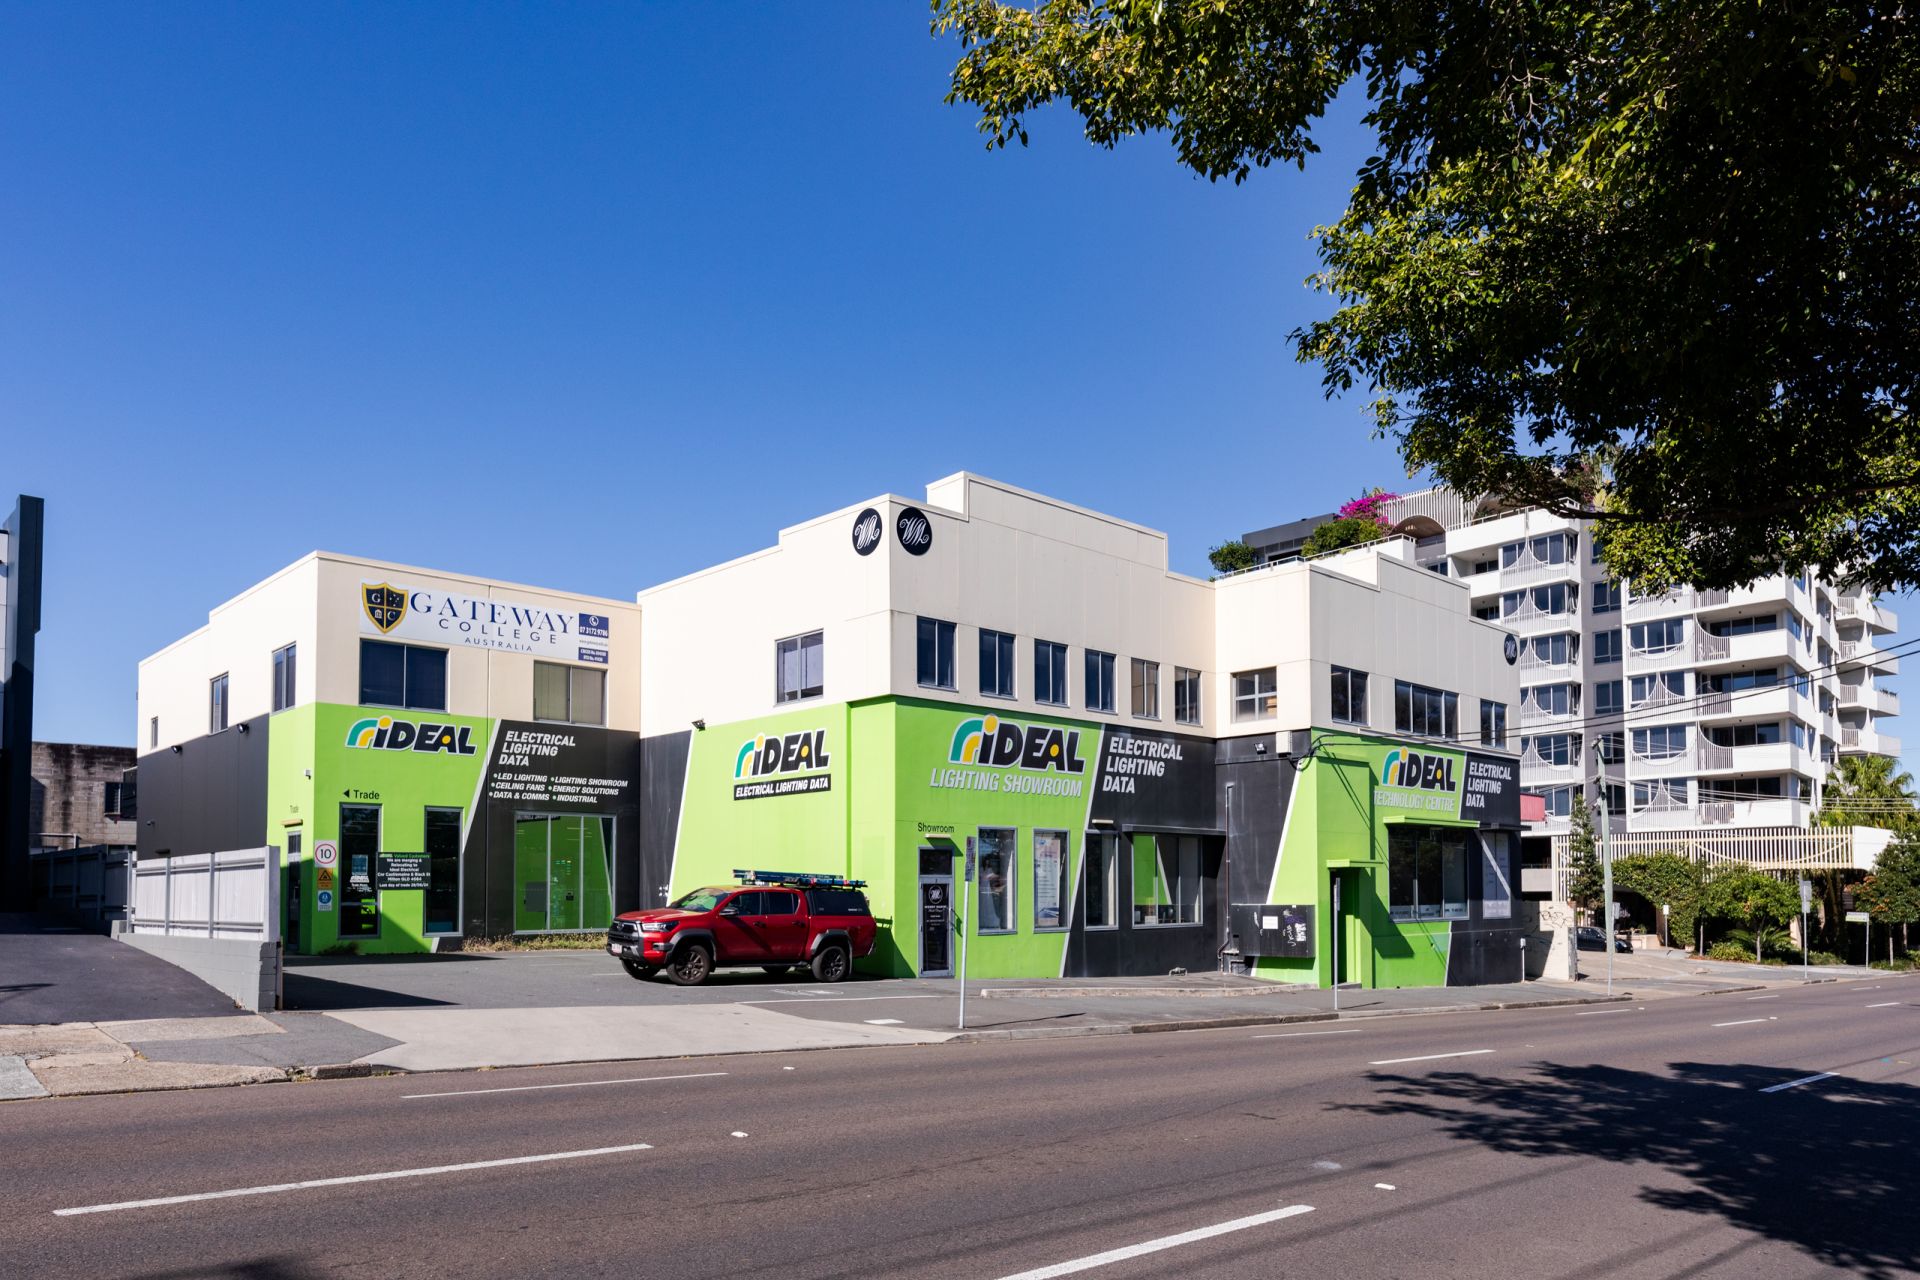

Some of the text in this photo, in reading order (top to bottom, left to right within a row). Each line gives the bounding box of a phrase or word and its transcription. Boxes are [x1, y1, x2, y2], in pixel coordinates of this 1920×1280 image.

[372, 593, 381, 603] G
[388, 610, 396, 620] C
[410, 592, 574, 634] GATEWAY
[439, 618, 556, 644] COLLEGE
[464, 637, 532, 652] AUSTRALIA
[506, 730, 576, 746] ELECTRICAL
[502, 742, 558, 756] LIGHTING
[1109, 736, 1183, 760] ELECTRICAL
[499, 754, 529, 766] DATA
[1106, 756, 1165, 777] LIGHTING
[514, 774, 548, 782] LIGHTING
[1469, 762, 1512, 780] ELECTRICAL
[495, 782, 545, 791] CEILING FANS
[554, 776, 628, 787] LIGHTING SHOWROOM
[736, 777, 828, 797] ELECTRICAL LIGHTING DATA
[930, 768, 1082, 797] LIGHTING SHOWROOM
[1102, 775, 1135, 793] DATA
[1467, 779, 1501, 794] LIGHTING
[353, 790, 380, 800] Trade
[552, 785, 619, 795] ENERGY SOLUTIONS
[557, 795, 598, 803] INDUSTRIAL
[1374, 790, 1455, 812] TECHNOLOGY CENTRE
[1466, 793, 1485, 808] DATA
[918, 822, 955, 833] Showroom
[320, 849, 332, 859] 10
